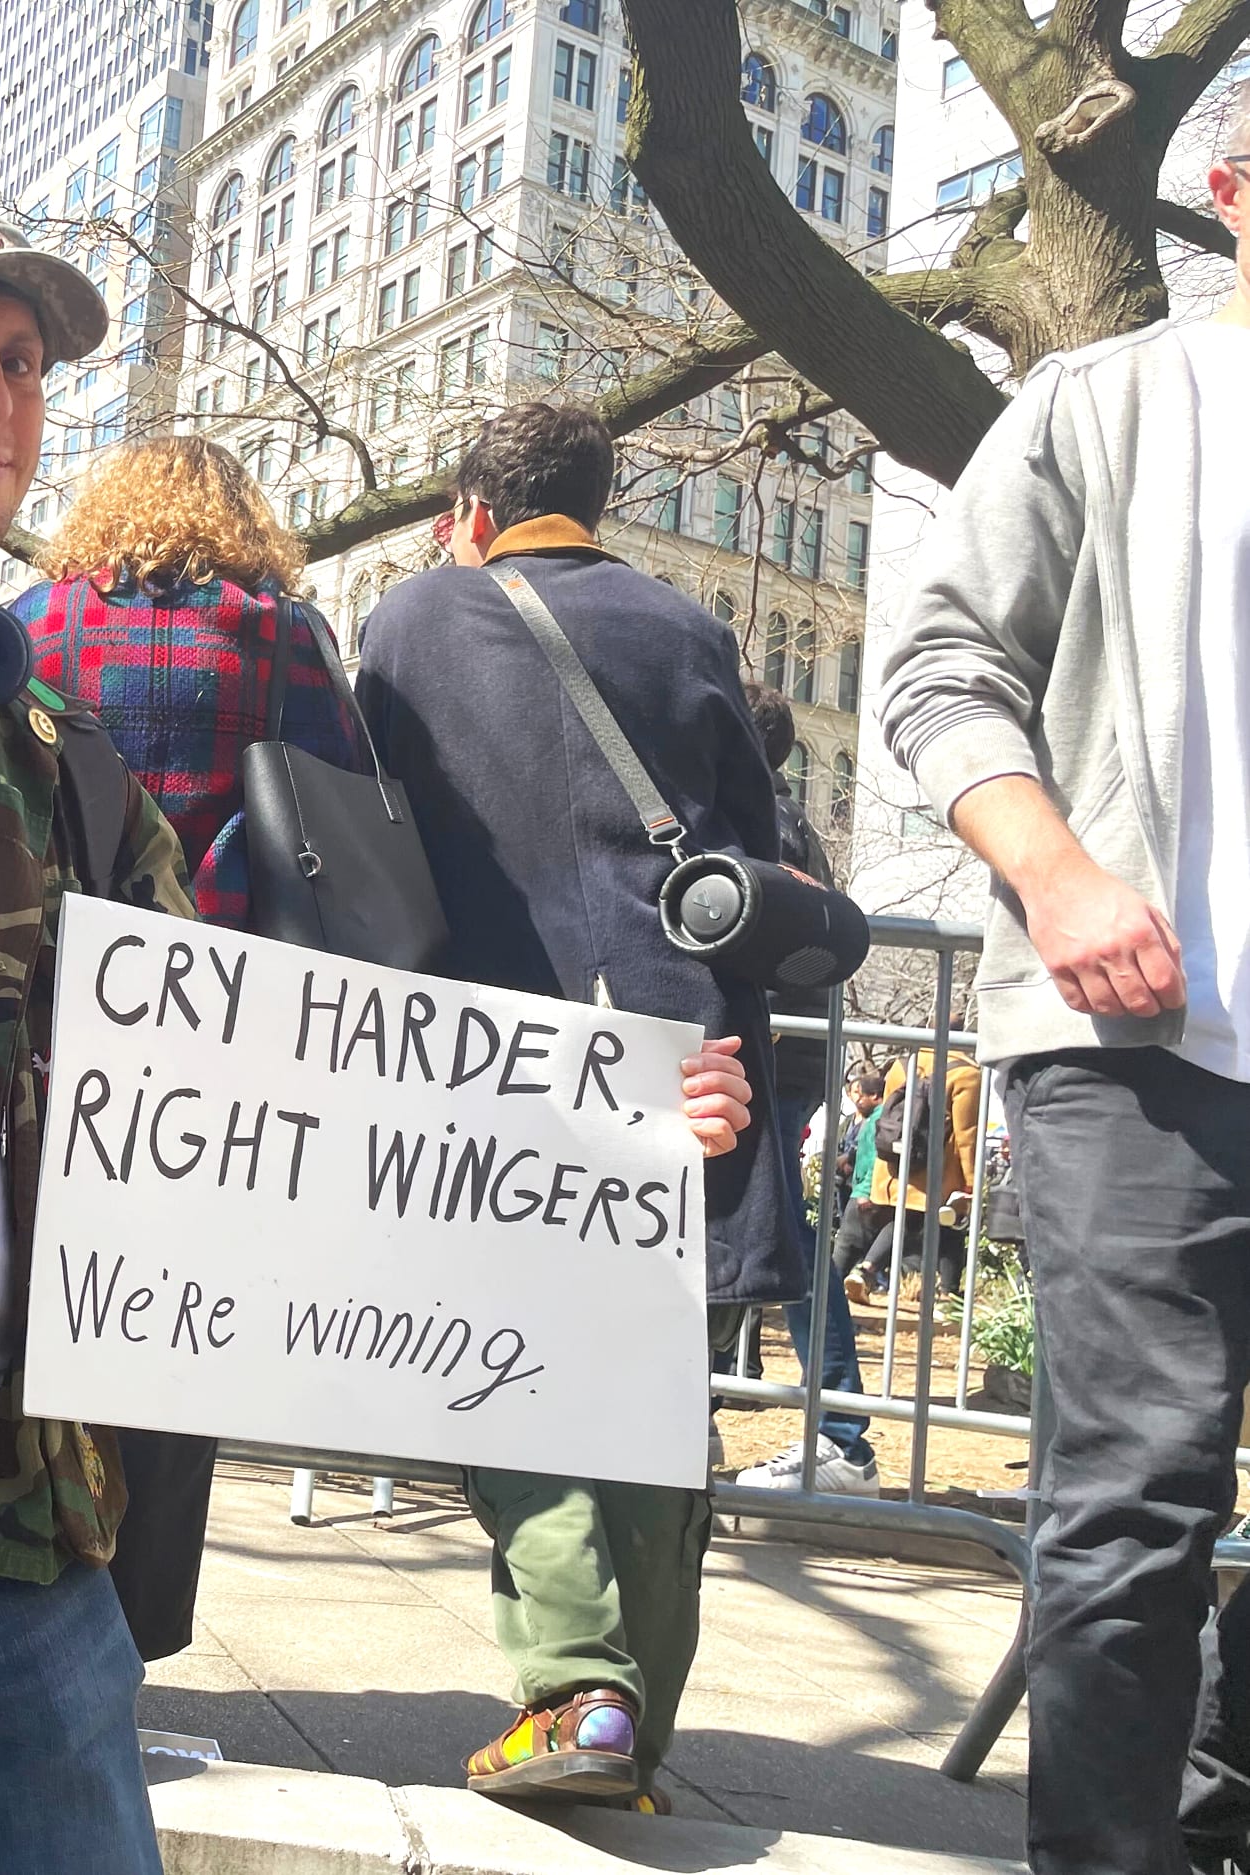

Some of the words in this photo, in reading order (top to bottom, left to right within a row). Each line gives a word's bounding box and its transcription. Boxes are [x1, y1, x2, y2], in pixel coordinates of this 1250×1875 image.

[95, 934, 248, 1044] CRY
[295, 970, 645, 1126] HARDER,
[285, 1297, 546, 1412] winning.
